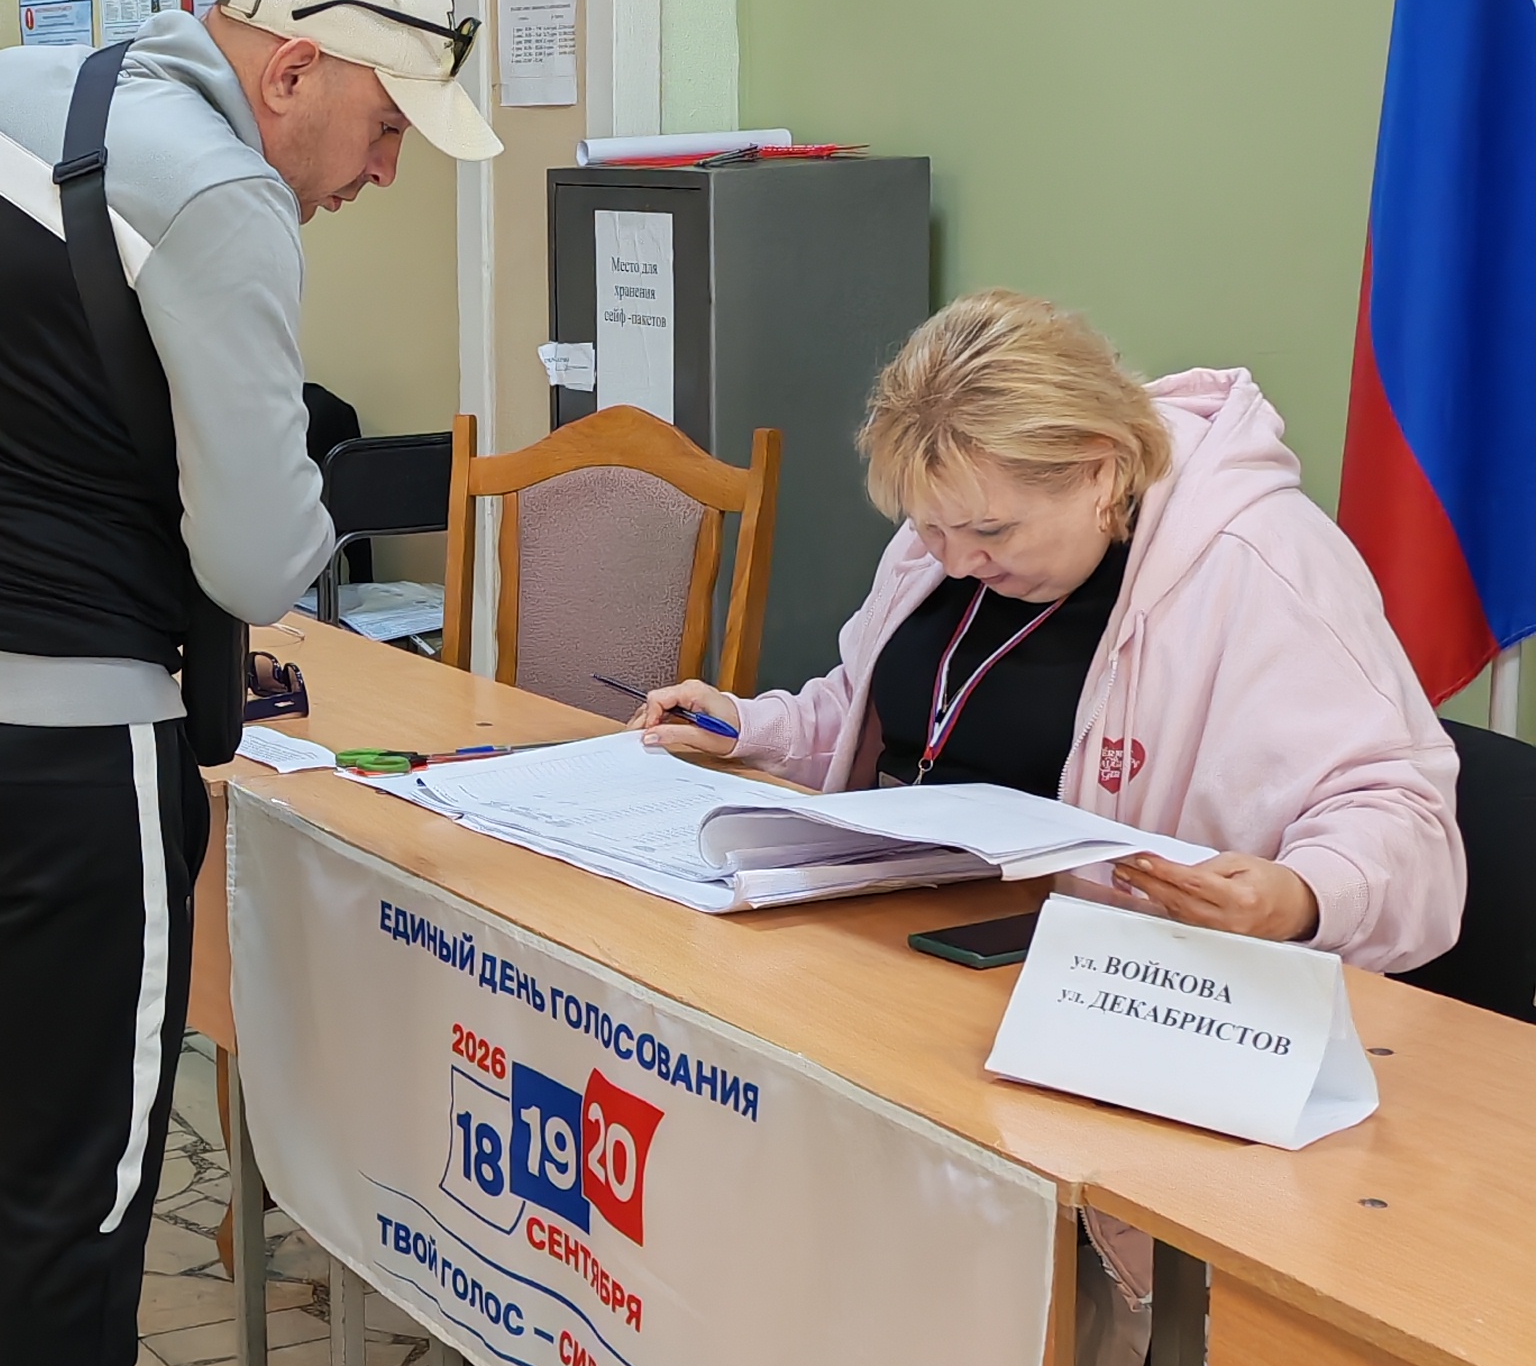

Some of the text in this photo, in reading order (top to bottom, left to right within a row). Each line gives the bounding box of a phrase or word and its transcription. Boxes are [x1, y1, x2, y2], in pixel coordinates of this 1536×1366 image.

[611, 255, 658, 276] Место для
[613, 283, 657, 301] хранения
[380, 900, 760, 1123] ЕДИНЫЙ ДЕНЬ ГОЛОСОВАНИЯ
[1068, 953, 1233, 1005] ул. ВОЙКОВА
[451, 1023, 507, 1080] 2026
[1057, 987, 1292, 1057] ул. ДЕКАБРИСТОВ
[456, 1101, 637, 1203] 18 19 20
[376, 1213, 439, 1278] ТВОЙ
[441, 1256, 525, 1336] ГОЛОС
[526, 1216, 643, 1333] СЕНТЯБРЯ
